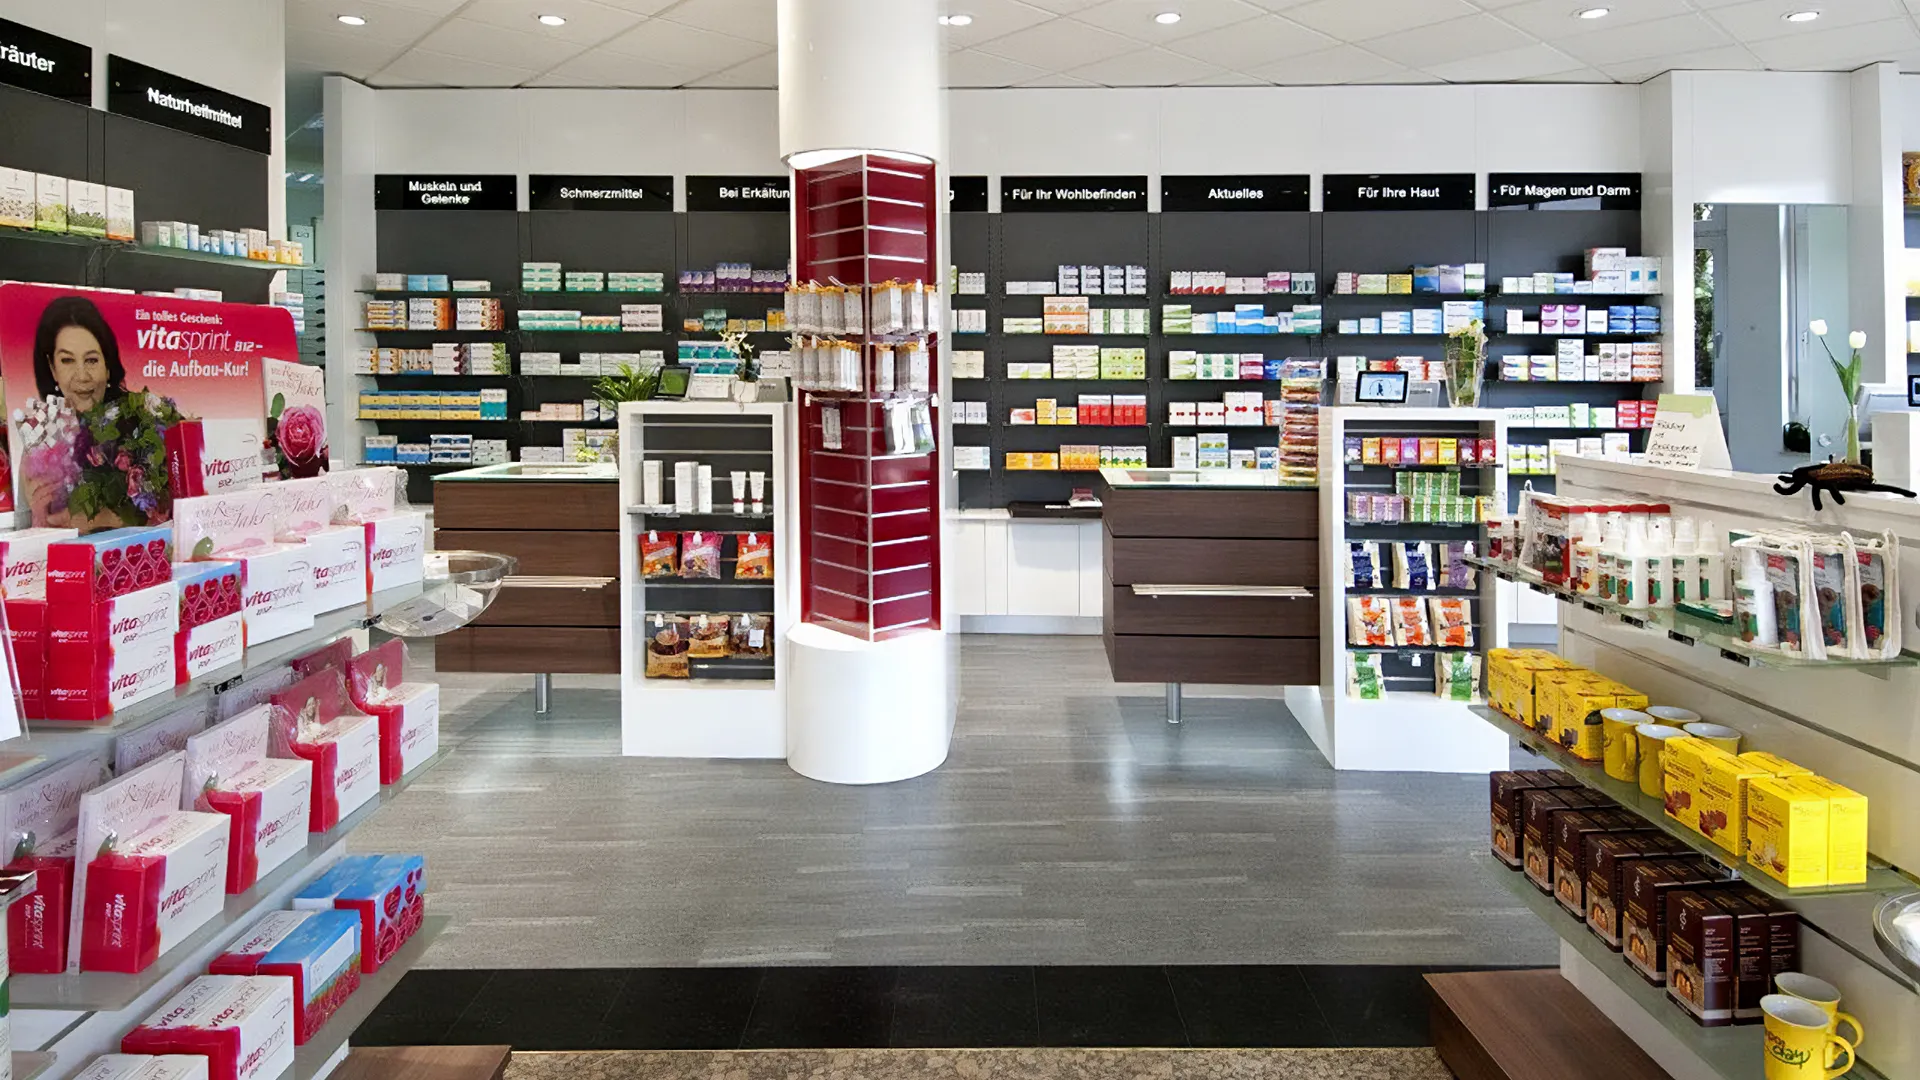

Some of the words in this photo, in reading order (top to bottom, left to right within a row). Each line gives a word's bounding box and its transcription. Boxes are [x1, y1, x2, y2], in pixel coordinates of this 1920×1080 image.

[0, 44, 56, 73] räuter
[146, 87, 242, 129] Naturheilmittel
[408, 180, 458, 192] Muskeln
[459, 180, 483, 192] und
[1357, 186, 1380, 198] Für
[1382, 186, 1407, 198] Ihre
[1410, 186, 1440, 198] Haut
[1499, 184, 1522, 196] Für
[1524, 184, 1567, 198] Magen
[1569, 184, 1595, 196] und
[1597, 184, 1631, 196] Darm
[420, 193, 471, 205] Gelenke
[559, 187, 643, 199] Schmerzmittel
[719, 187, 739, 199] Bei
[741, 187, 790, 199] Erkältun
[1012, 188, 1034, 200] Für
[1035, 188, 1053, 200] Ihr
[1054, 188, 1137, 200] Wohlbefinden
[1207, 187, 1264, 200] Aktuelles
[135, 308, 151, 321] Ein
[152, 310, 178, 322] tolles
[180, 311, 223, 325] Geschenk:
[137, 323, 231, 359] vitasprint
[143, 360, 166, 377] die
[169, 360, 249, 377] Aufbau-Kur!
